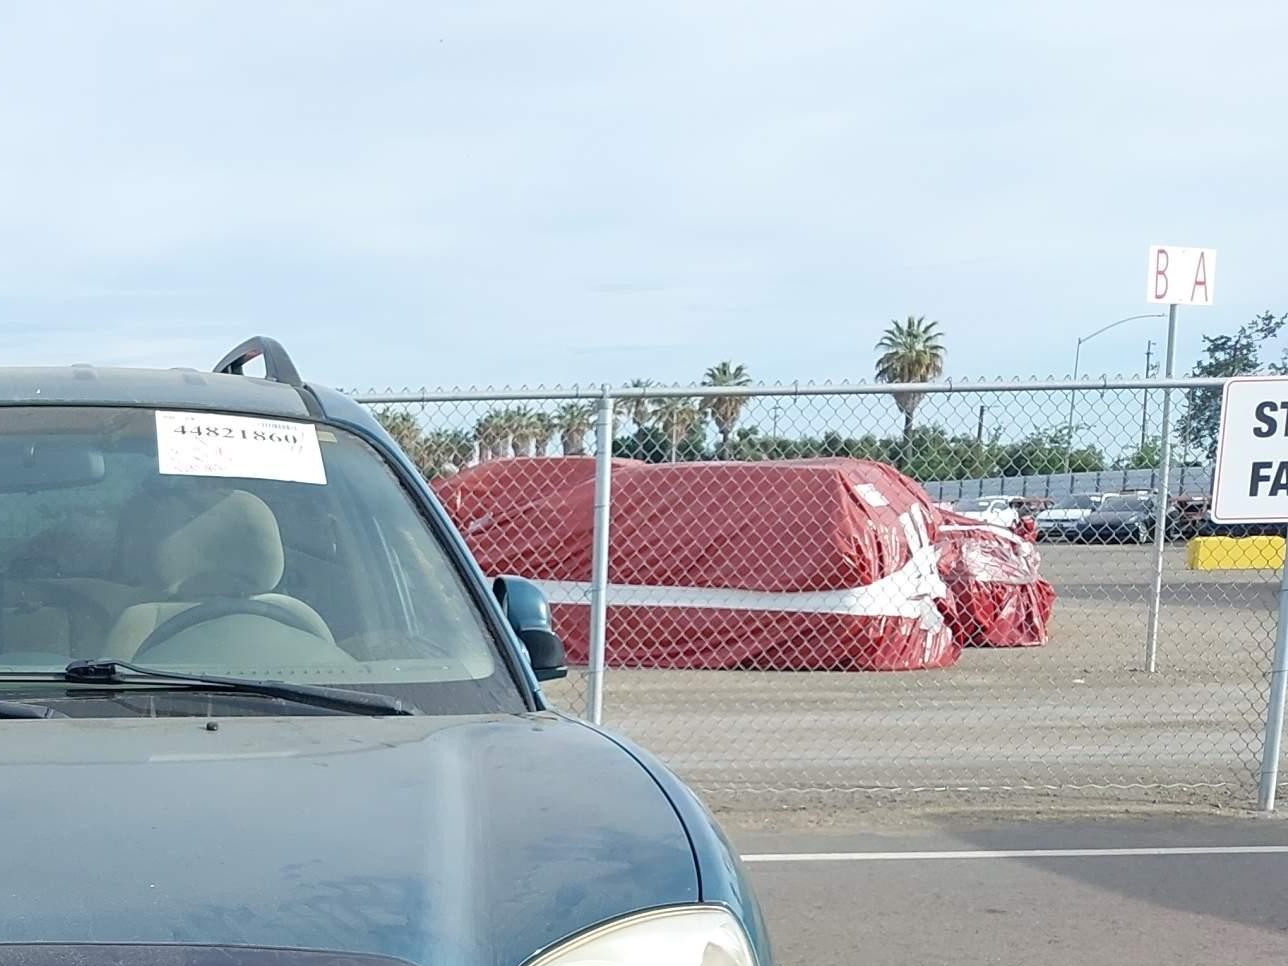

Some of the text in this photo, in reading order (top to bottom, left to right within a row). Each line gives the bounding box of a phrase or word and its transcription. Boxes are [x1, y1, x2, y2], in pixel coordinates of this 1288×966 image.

[1154, 248, 1209, 302] B A
[173, 424, 298, 444] 44821860
[1249, 461, 1288, 497] FA
